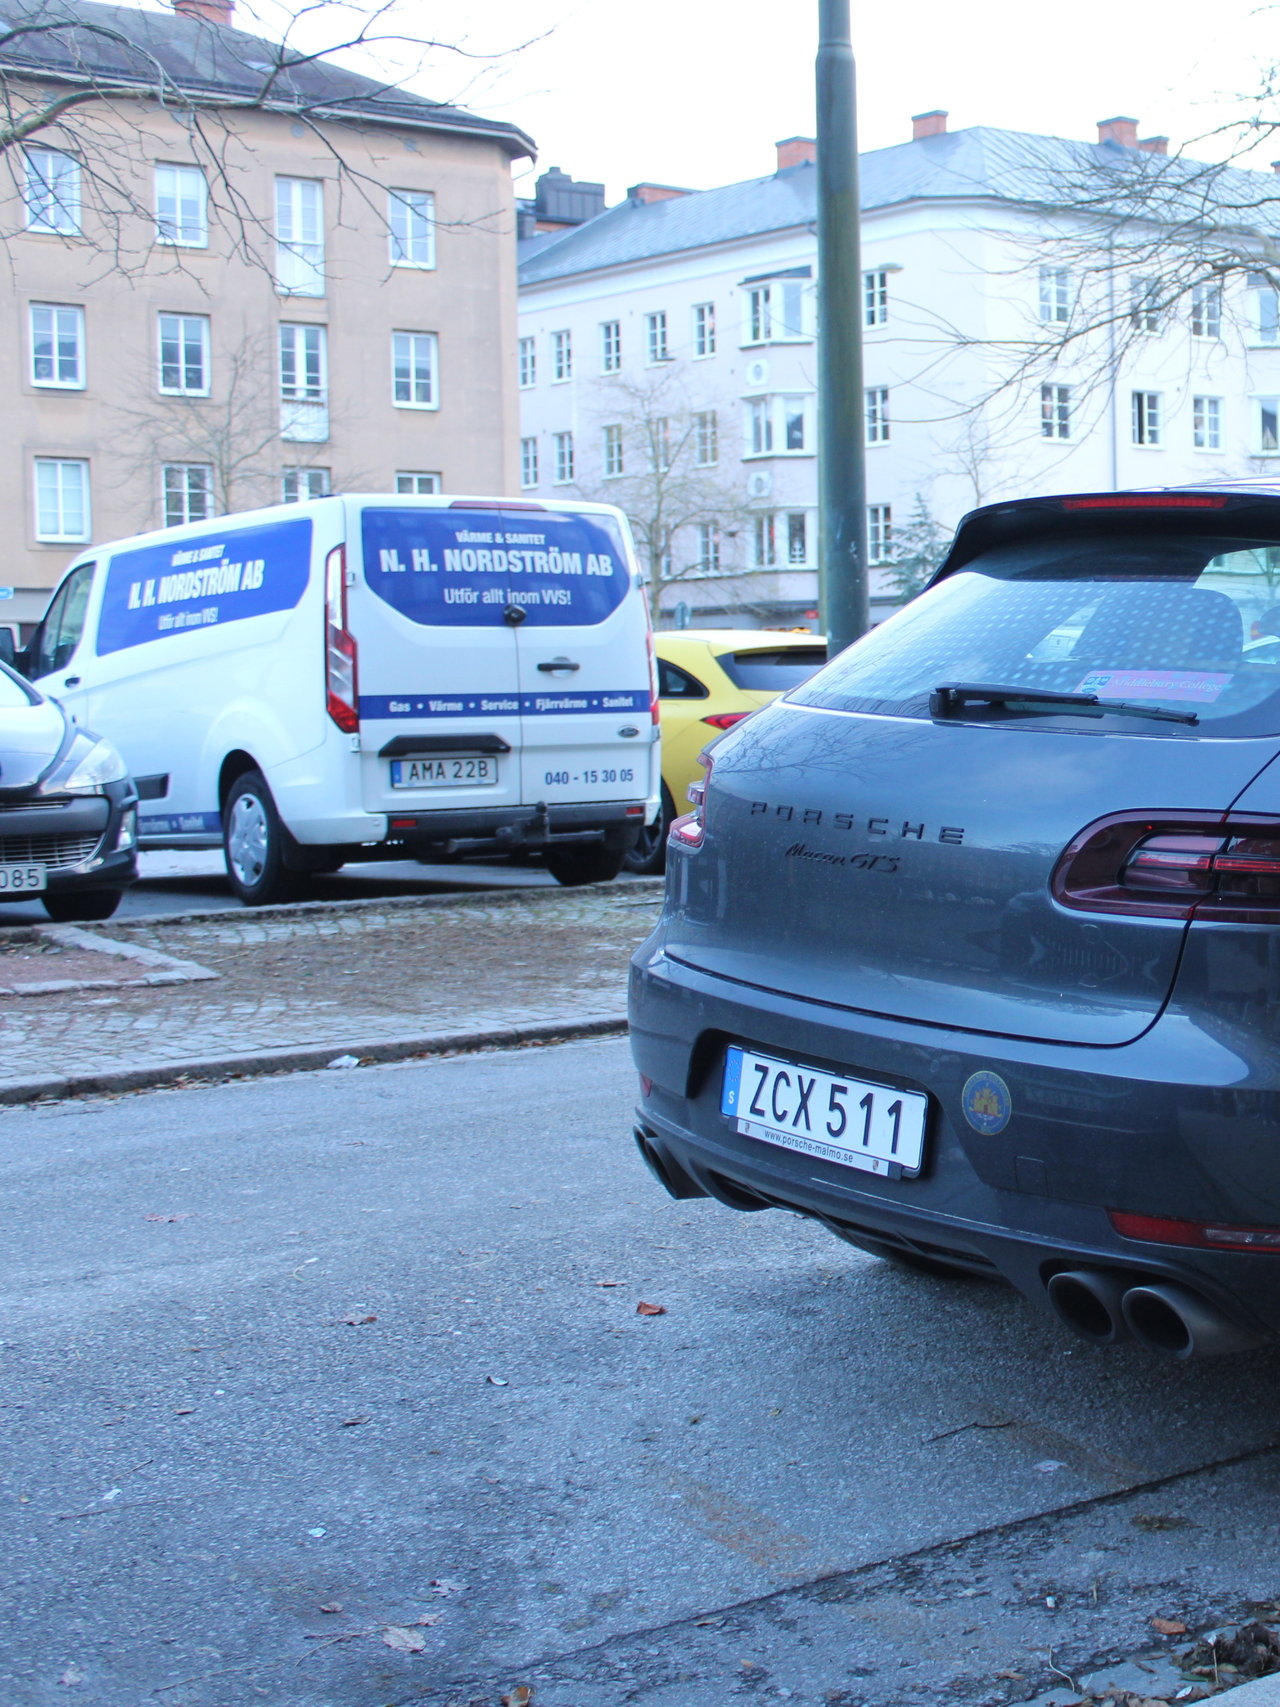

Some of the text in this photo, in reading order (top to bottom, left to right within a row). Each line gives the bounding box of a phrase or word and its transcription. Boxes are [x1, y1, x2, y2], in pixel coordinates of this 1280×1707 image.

[455, 529, 546, 546] VÄRME & SANITET
[379, 547, 614, 577] N. H. NORDSTRÖM AB
[142, 579, 156, 607] H.
[157, 558, 243, 605] NORDSTRÖM
[240, 559, 266, 591] AB
[444, 587, 572, 606] Utför allt inom VVS!
[1111, 678, 1222, 693] Middlebury College
[389, 701, 411, 713] Gas
[428, 699, 464, 712] Värme
[480, 699, 519, 711] Service
[409, 760, 489, 781] AMA 22B
[545, 771, 572, 786] 040
[583, 770, 598, 784] 15
[602, 769, 617, 783] 30
[620, 768, 634, 782] 05
[751, 801, 965, 845] PORSCHE
[785, 842, 901, 873] Macan GTS
[728, 1090, 735, 1104] S
[749, 1063, 817, 1132] ZCX
[826, 1083, 903, 1155] 511
[764, 1129, 854, 1163] www.porsche-malmo.se
